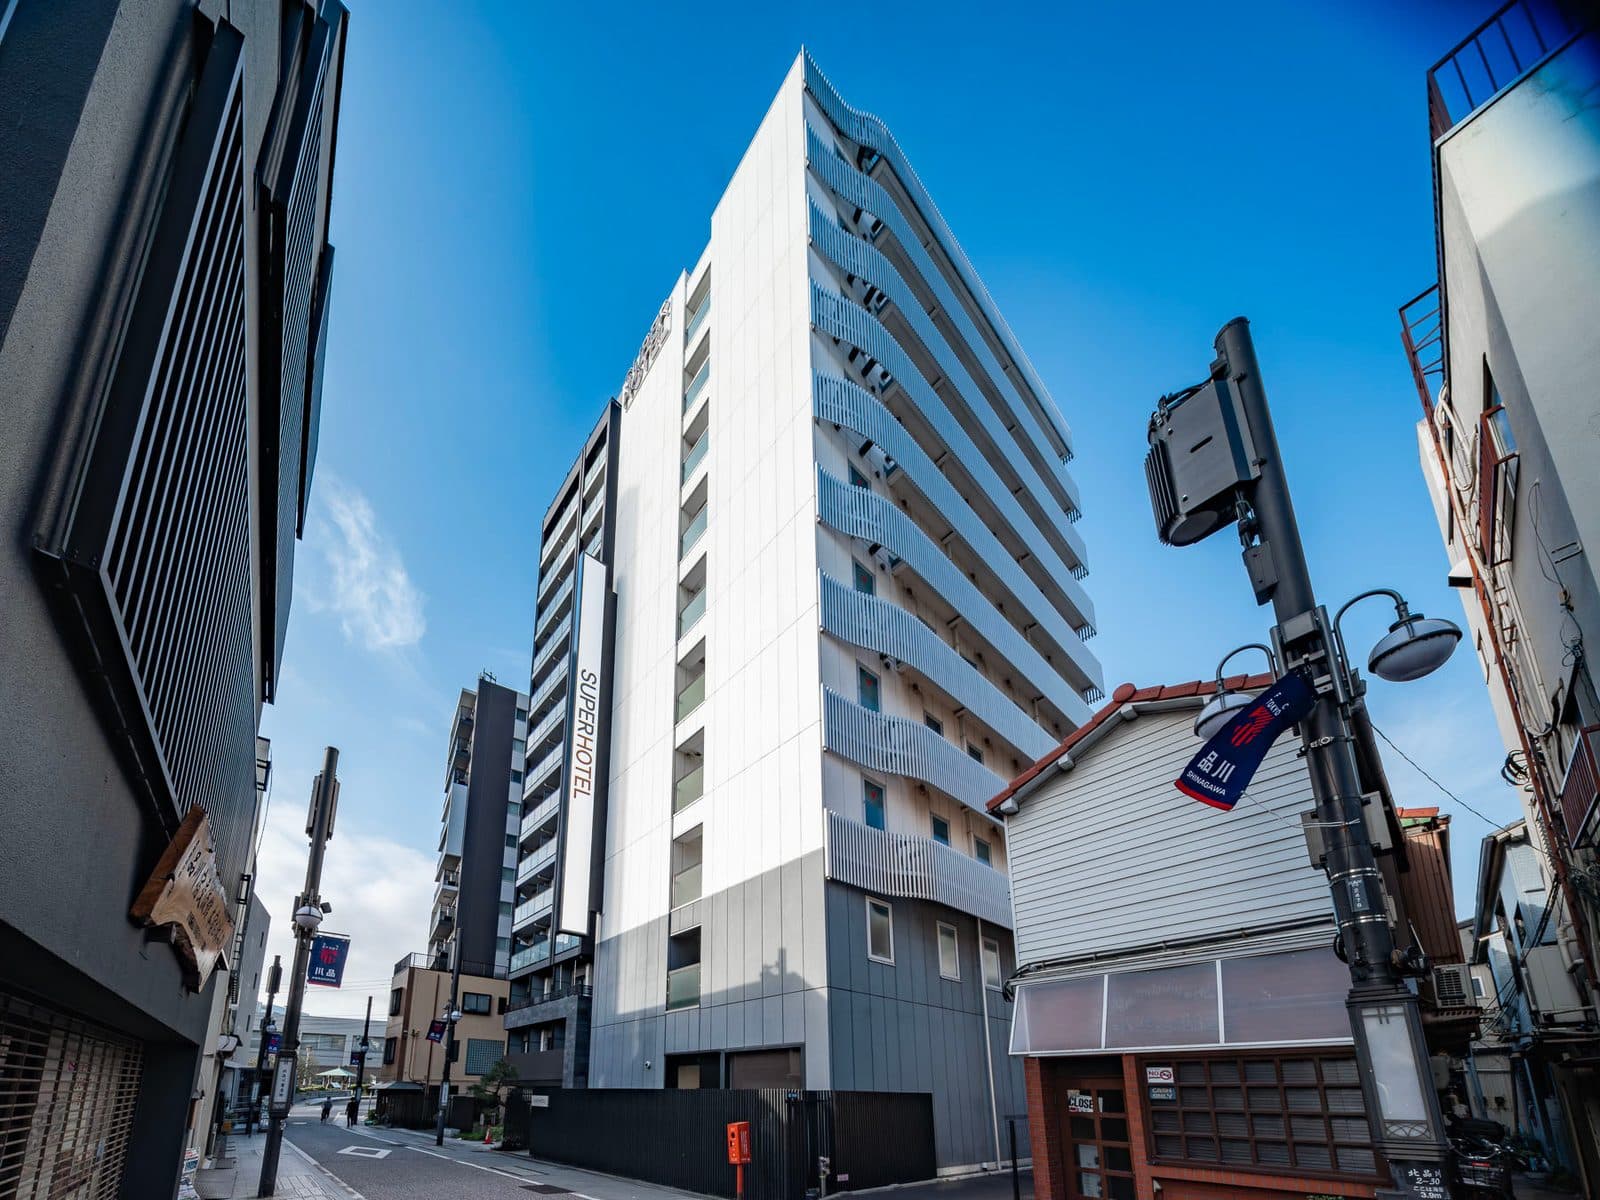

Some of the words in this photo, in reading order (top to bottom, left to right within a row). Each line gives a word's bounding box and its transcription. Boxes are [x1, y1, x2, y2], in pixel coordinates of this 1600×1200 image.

[1266, 698, 1282, 717] TOKYO
[573, 668, 598, 799] SUPERHOTEL
[1197, 750, 1236, 783] 品川
[1186, 770, 1226, 796] SHINAGAWA
